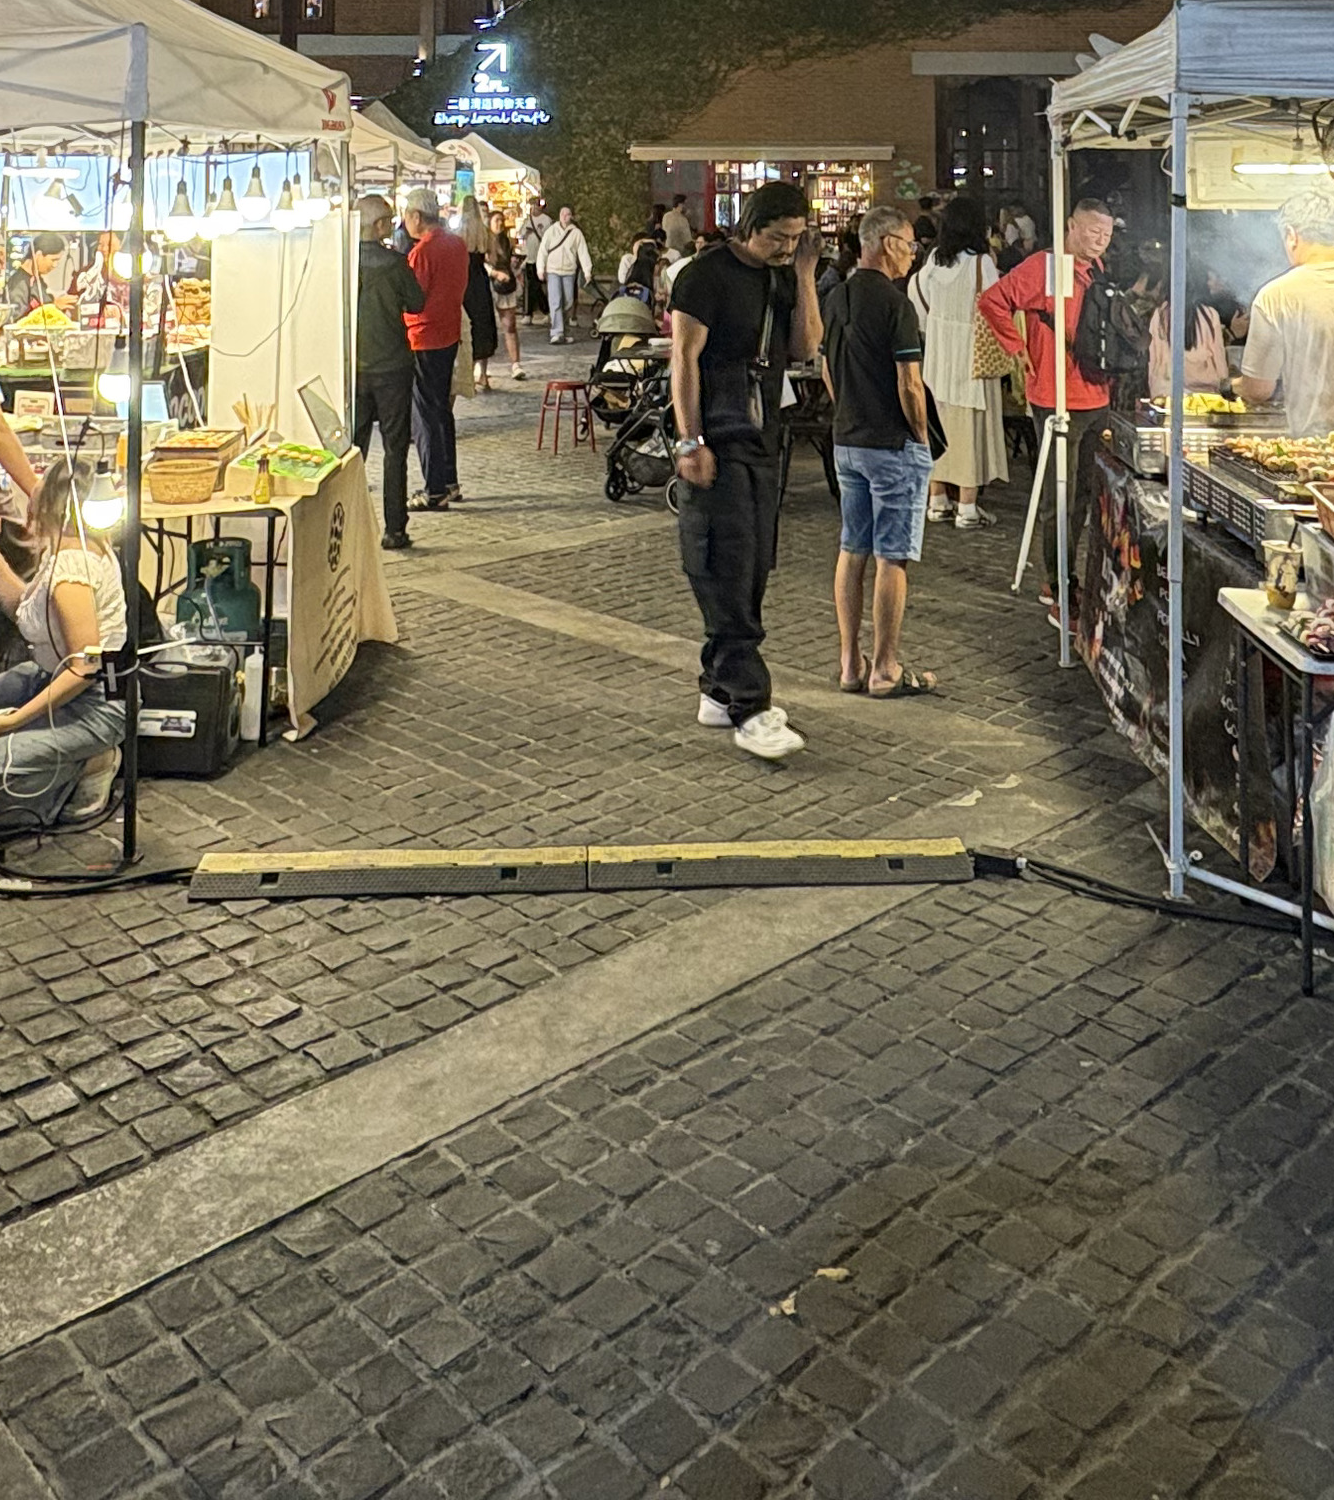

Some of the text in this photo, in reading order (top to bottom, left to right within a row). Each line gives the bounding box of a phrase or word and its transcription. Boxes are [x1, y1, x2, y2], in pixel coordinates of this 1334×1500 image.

[434, 111, 550, 127] Shop Local Craft
